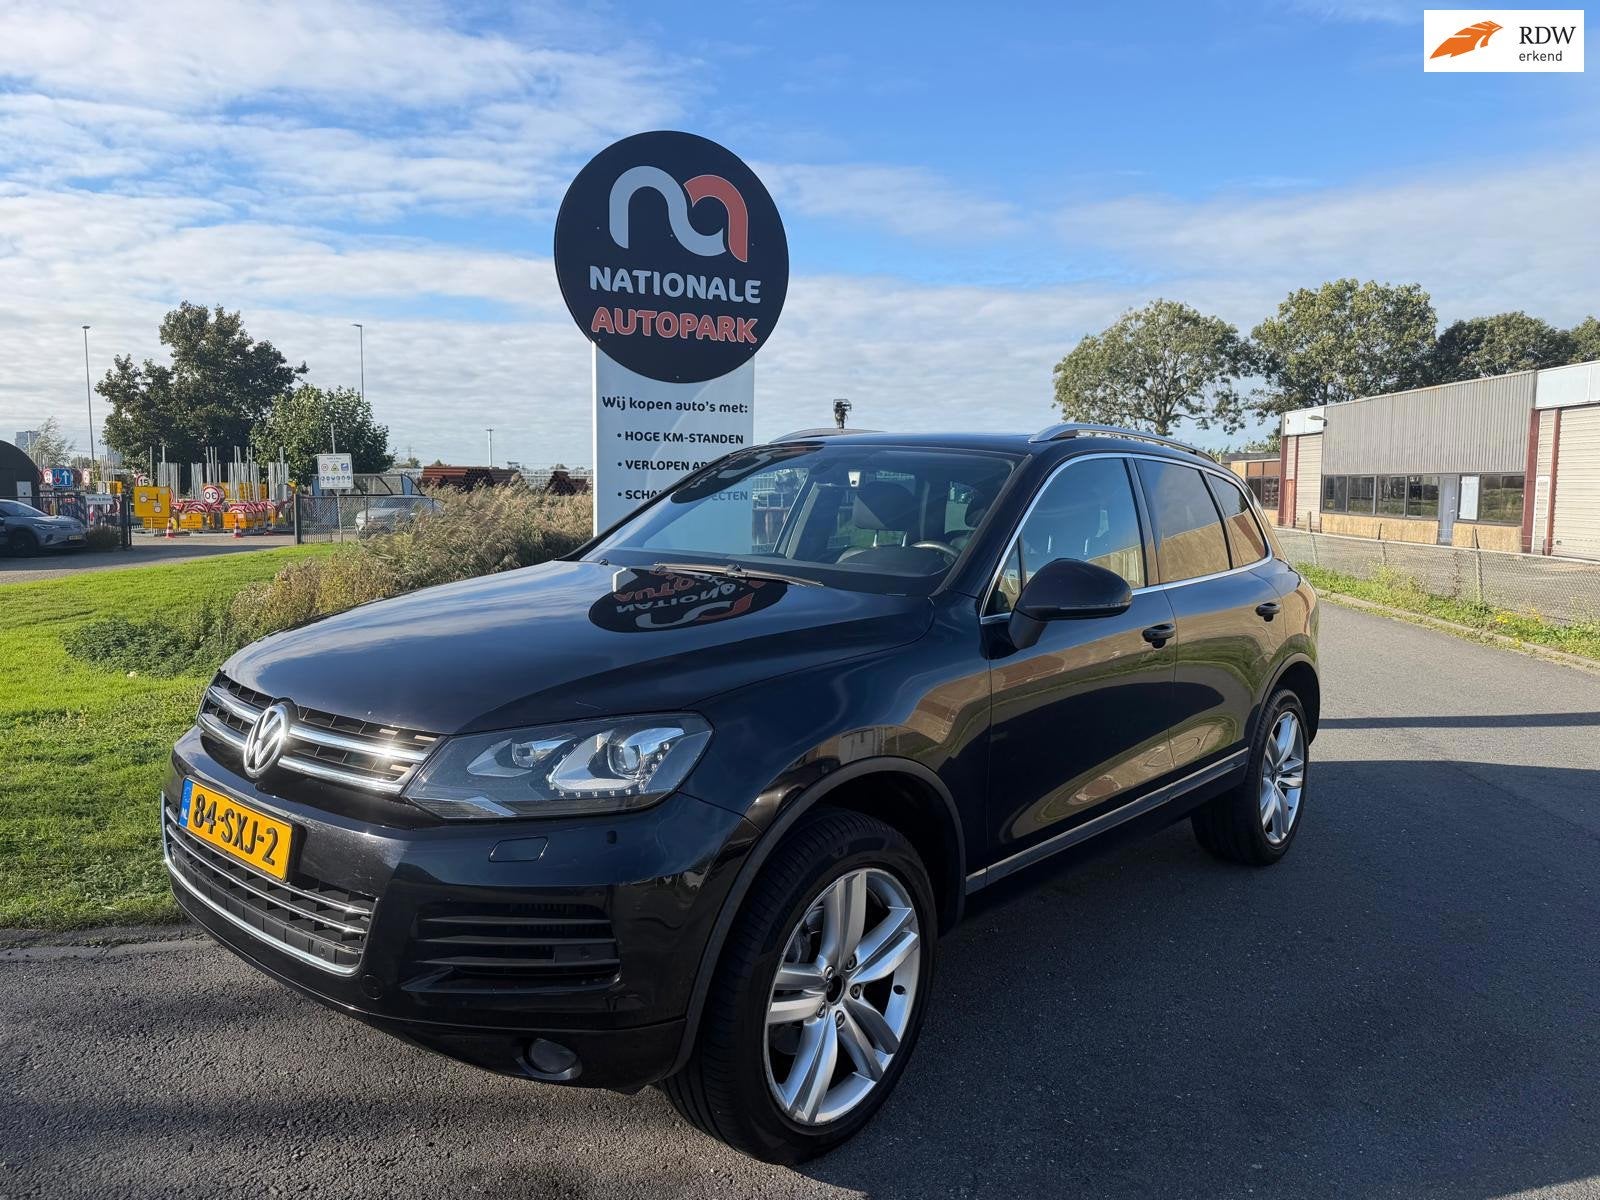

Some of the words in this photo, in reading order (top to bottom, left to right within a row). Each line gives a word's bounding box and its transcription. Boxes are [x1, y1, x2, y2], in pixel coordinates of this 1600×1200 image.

[589, 265, 762, 304] NATIONALE
[591, 306, 759, 344] AUTOPARK
[602, 396, 626, 411] Wij
[629, 397, 672, 412] kopen
[675, 401, 716, 412] auto's
[719, 403, 748, 414] met:
[624, 431, 660, 442] HOGE
[663, 432, 744, 444] KM-STANDEN
[625, 460, 690, 471] VERLOPEN
[194, 794, 279, 866] 84-SXJ-2
